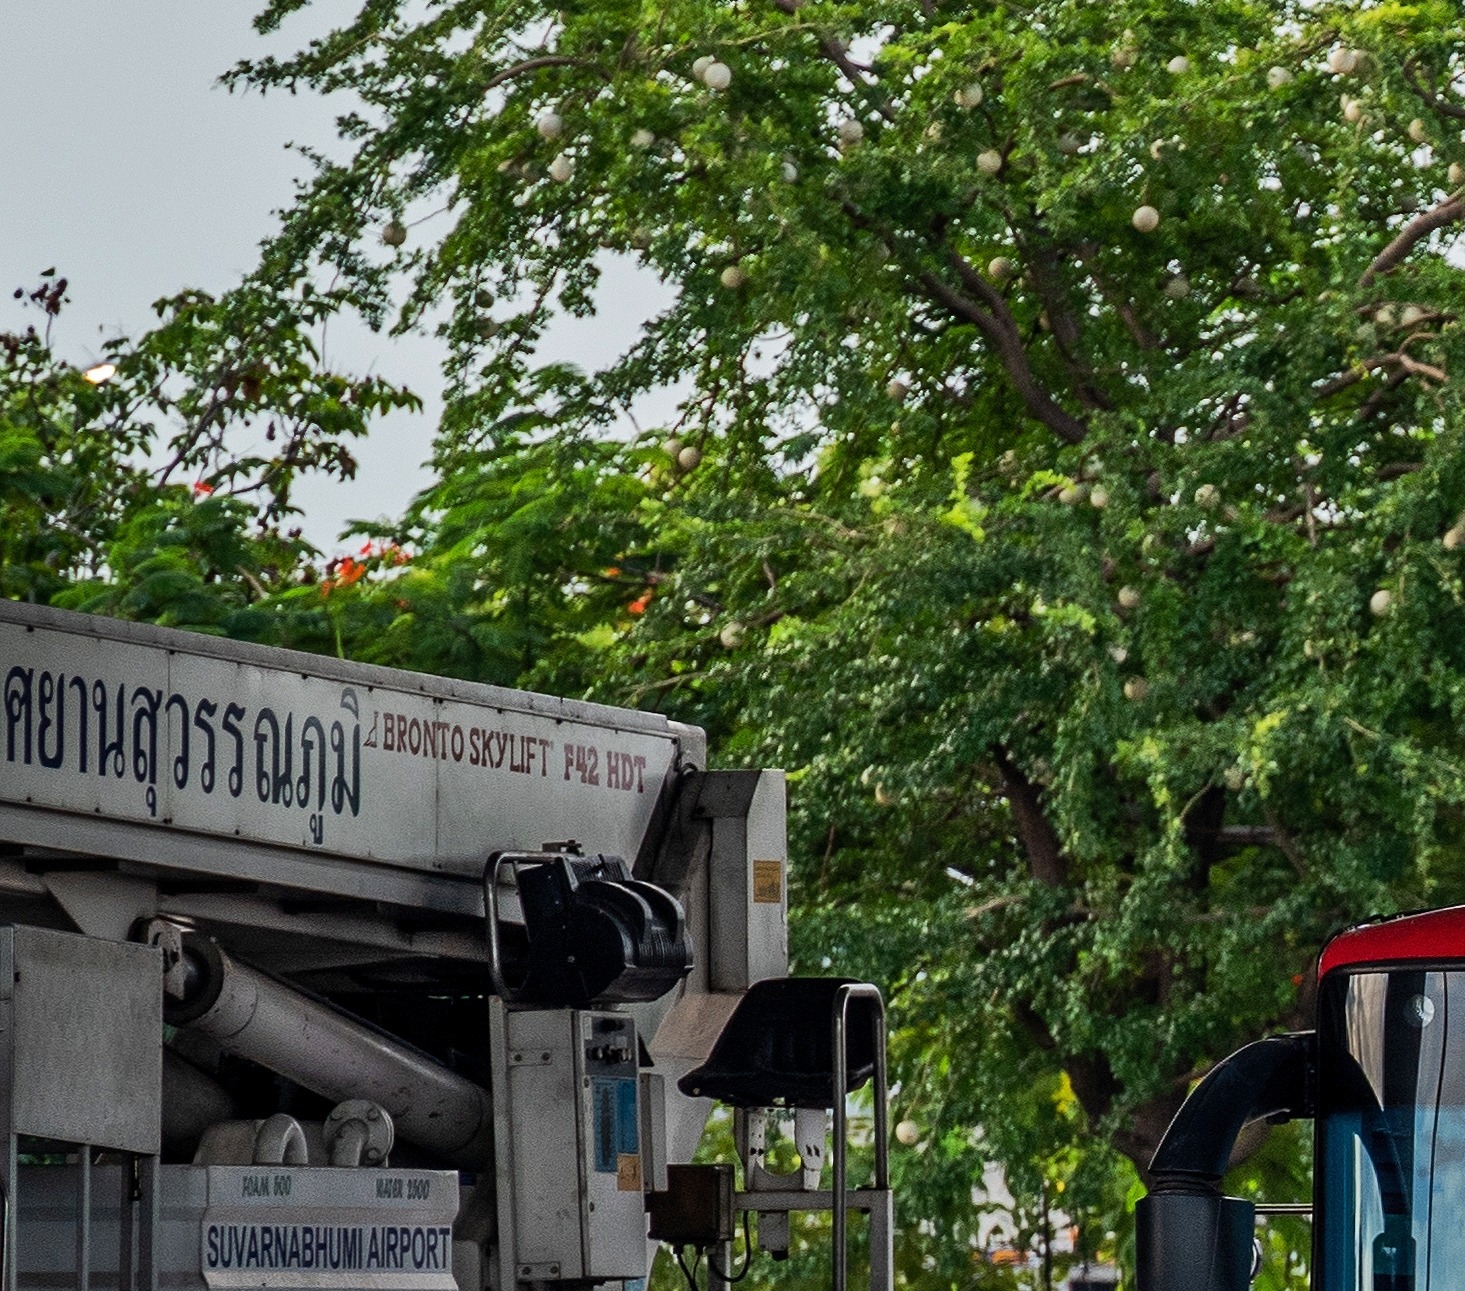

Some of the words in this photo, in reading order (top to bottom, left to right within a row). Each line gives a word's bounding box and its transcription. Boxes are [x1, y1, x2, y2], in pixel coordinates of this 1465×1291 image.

[3, 665, 361, 845] ศยานสุวรรณภูมิ
[383, 712, 465, 763] BRONTO
[469, 726, 551, 778] SKYLIFT
[606, 750, 646, 794] HDT
[207, 1225, 363, 1270] SUVARNABHUMI
[366, 1227, 451, 1270] AIRPORT
